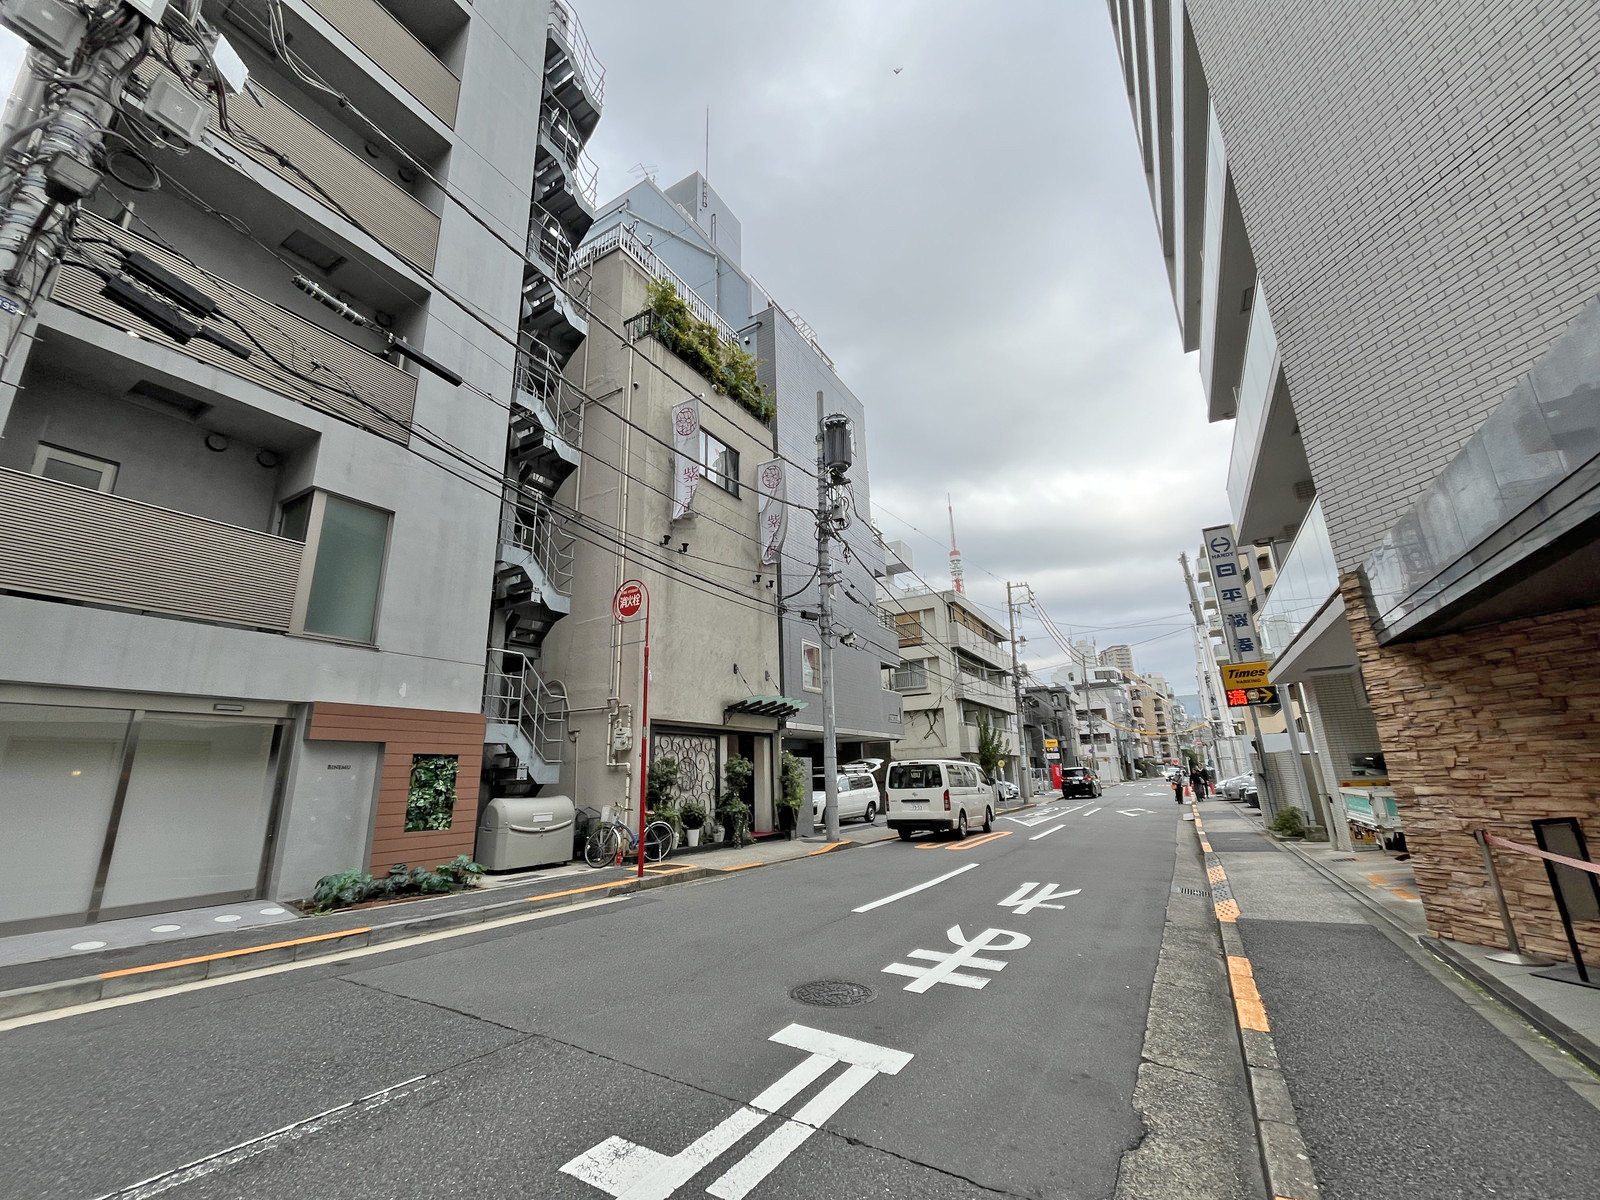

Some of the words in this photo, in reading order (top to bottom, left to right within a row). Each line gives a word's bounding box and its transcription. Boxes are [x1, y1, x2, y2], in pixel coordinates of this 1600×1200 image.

[620, 593, 641, 609] 消火栓
[1228, 669, 1266, 679] Times
[1227, 690, 1248, 705] 満
[558, 882, 1083, 1200] 止まれ
